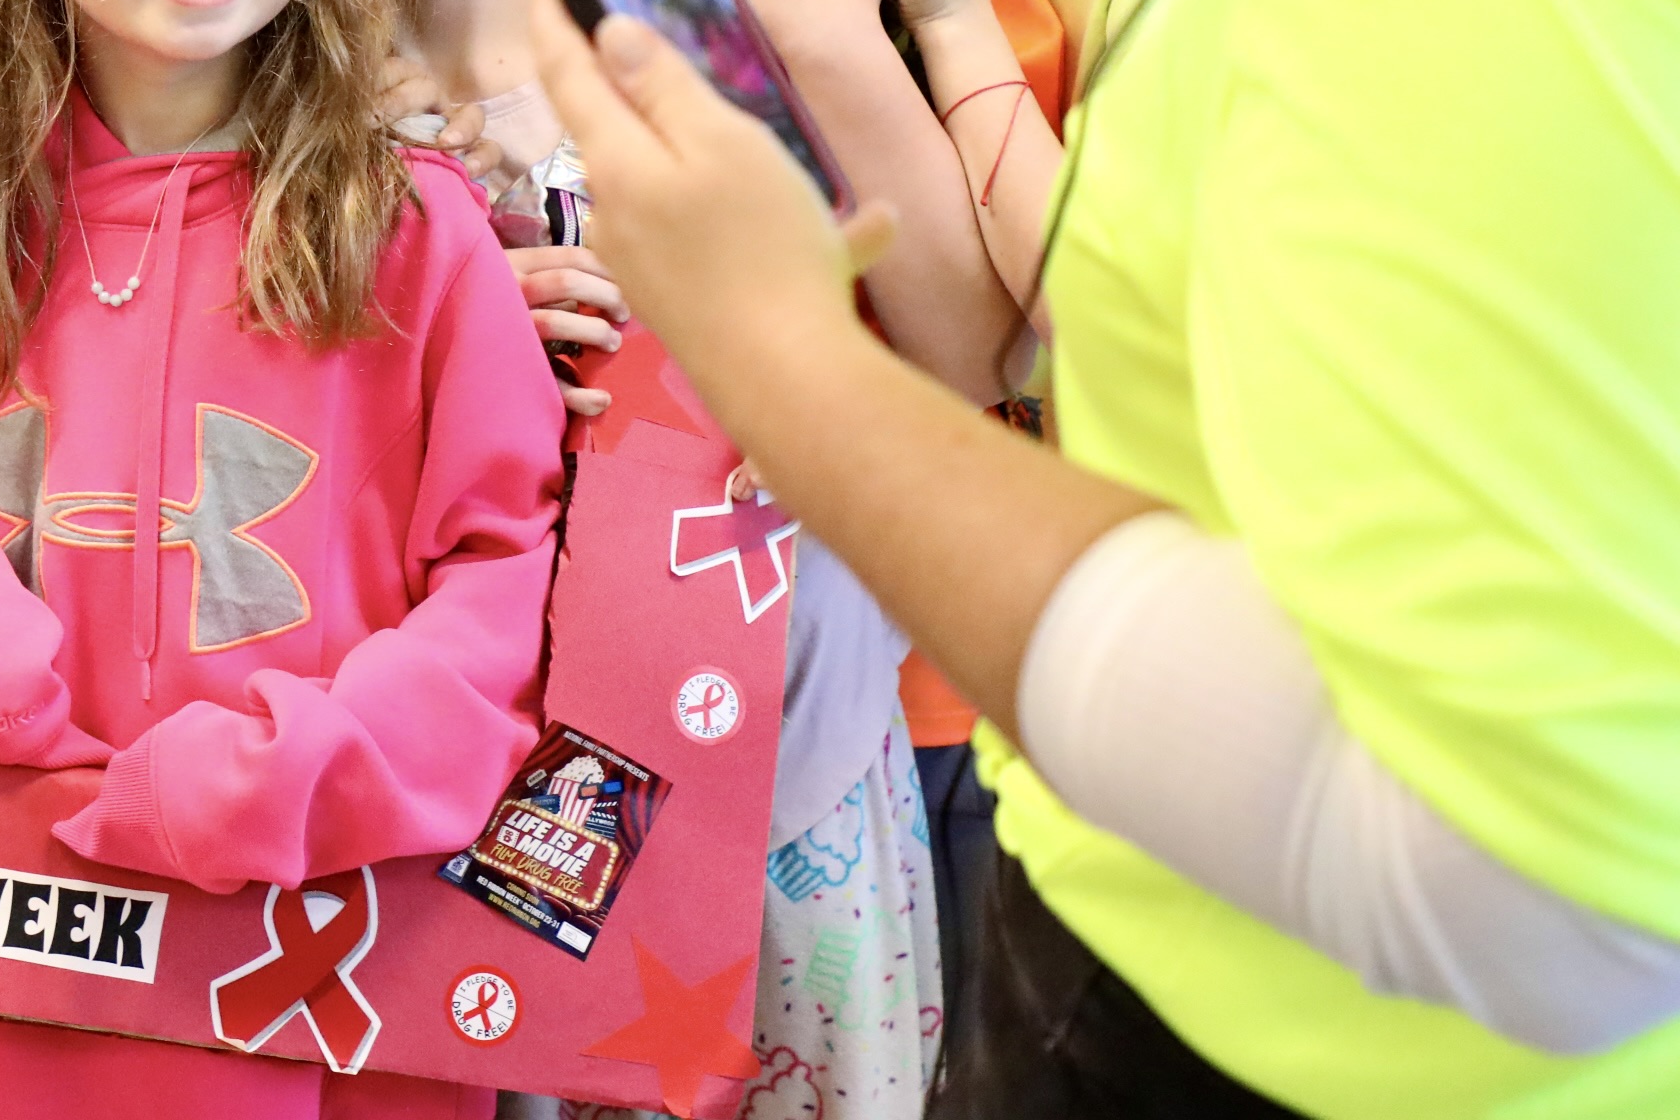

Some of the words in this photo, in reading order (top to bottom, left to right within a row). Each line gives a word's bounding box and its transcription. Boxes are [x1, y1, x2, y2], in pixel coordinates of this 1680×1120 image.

[678, 693, 692, 725] DRUG
[695, 724, 726, 736] FREE!
[727, 690, 735, 701] TO
[505, 810, 553, 840] LIFE
[548, 828, 578, 851] IS
[573, 841, 596, 862] A
[490, 843, 518, 863] FILM
[516, 854, 553, 880] DRUG
[553, 873, 584, 894] FREE
[515, 834, 588, 880] MOVIE.
[543, 915, 560, 929] 23-31
[466, 976, 498, 986] PLEDGE
[500, 984, 510, 996] TO
[507, 999, 514, 1010] BE
[452, 1001, 472, 1032] DRUG
[476, 1021, 508, 1038] FREE!
